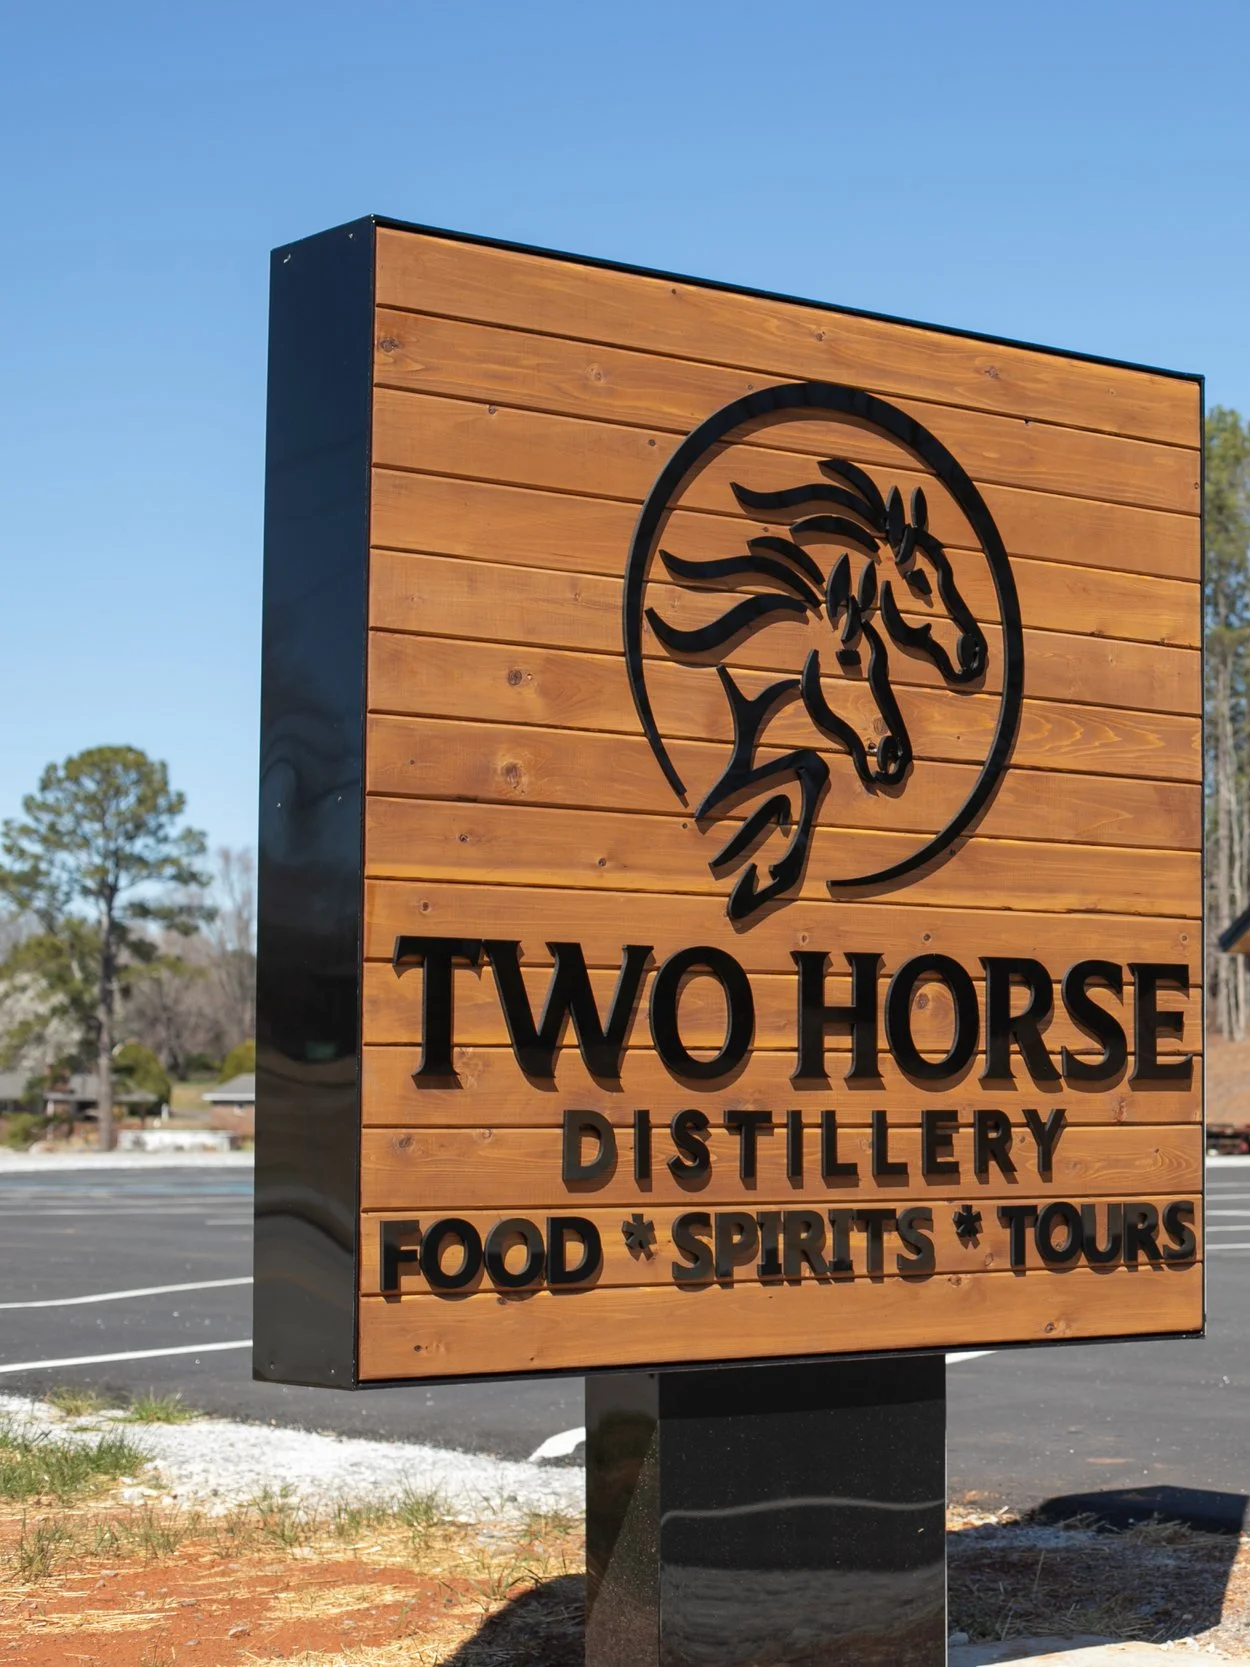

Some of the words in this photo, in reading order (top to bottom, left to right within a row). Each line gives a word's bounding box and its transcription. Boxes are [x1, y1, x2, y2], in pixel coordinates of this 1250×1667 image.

[394, 935, 755, 1080] TWO
[791, 951, 1194, 1082] HORSE
[563, 1107, 1067, 1183] DISTILLERY
[380, 1215, 602, 1292] FOOD
[672, 1206, 935, 1281] SPIRITS
[997, 1201, 1197, 1266] TOURS
